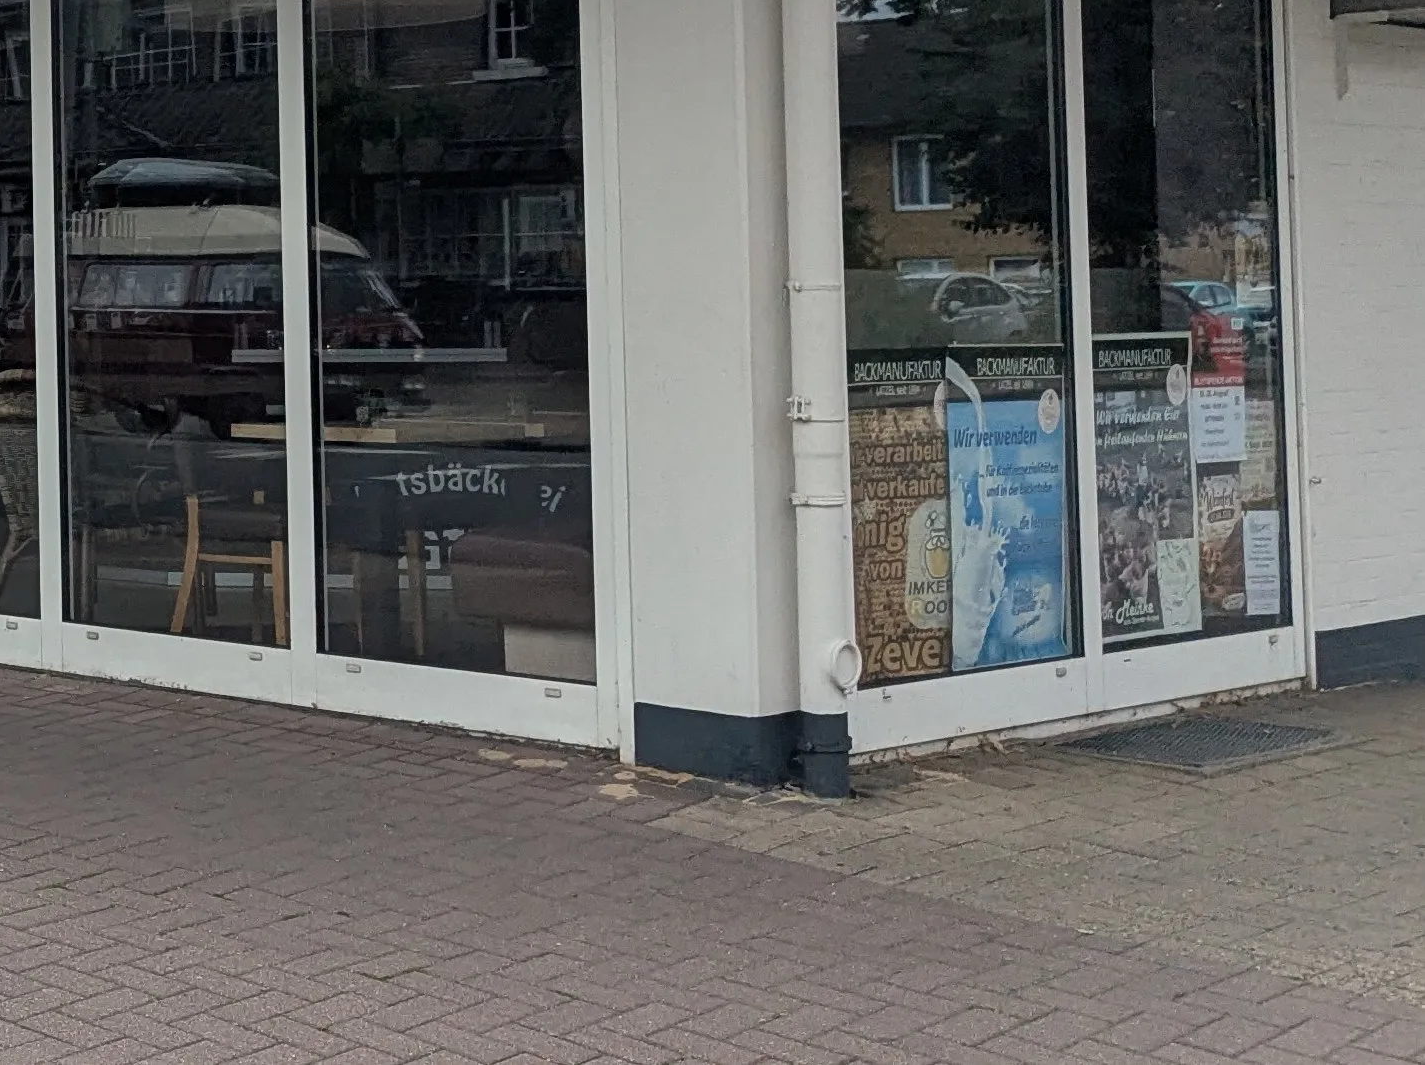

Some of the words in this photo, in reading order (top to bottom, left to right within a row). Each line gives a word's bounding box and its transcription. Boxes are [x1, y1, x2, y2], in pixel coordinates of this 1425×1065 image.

[976, 357, 1056, 376] BACKMANUFAKTUR
[1097, 348, 1172, 368] BACKMANUFAKTUR
[854, 360, 943, 382] BACKMANUFAKTUR
[953, 427, 975, 448] Wir
[976, 425, 1038, 447] verwenden
[865, 438, 946, 464] verarbeit
[869, 559, 904, 582] von
[865, 634, 948, 676] Zeve
